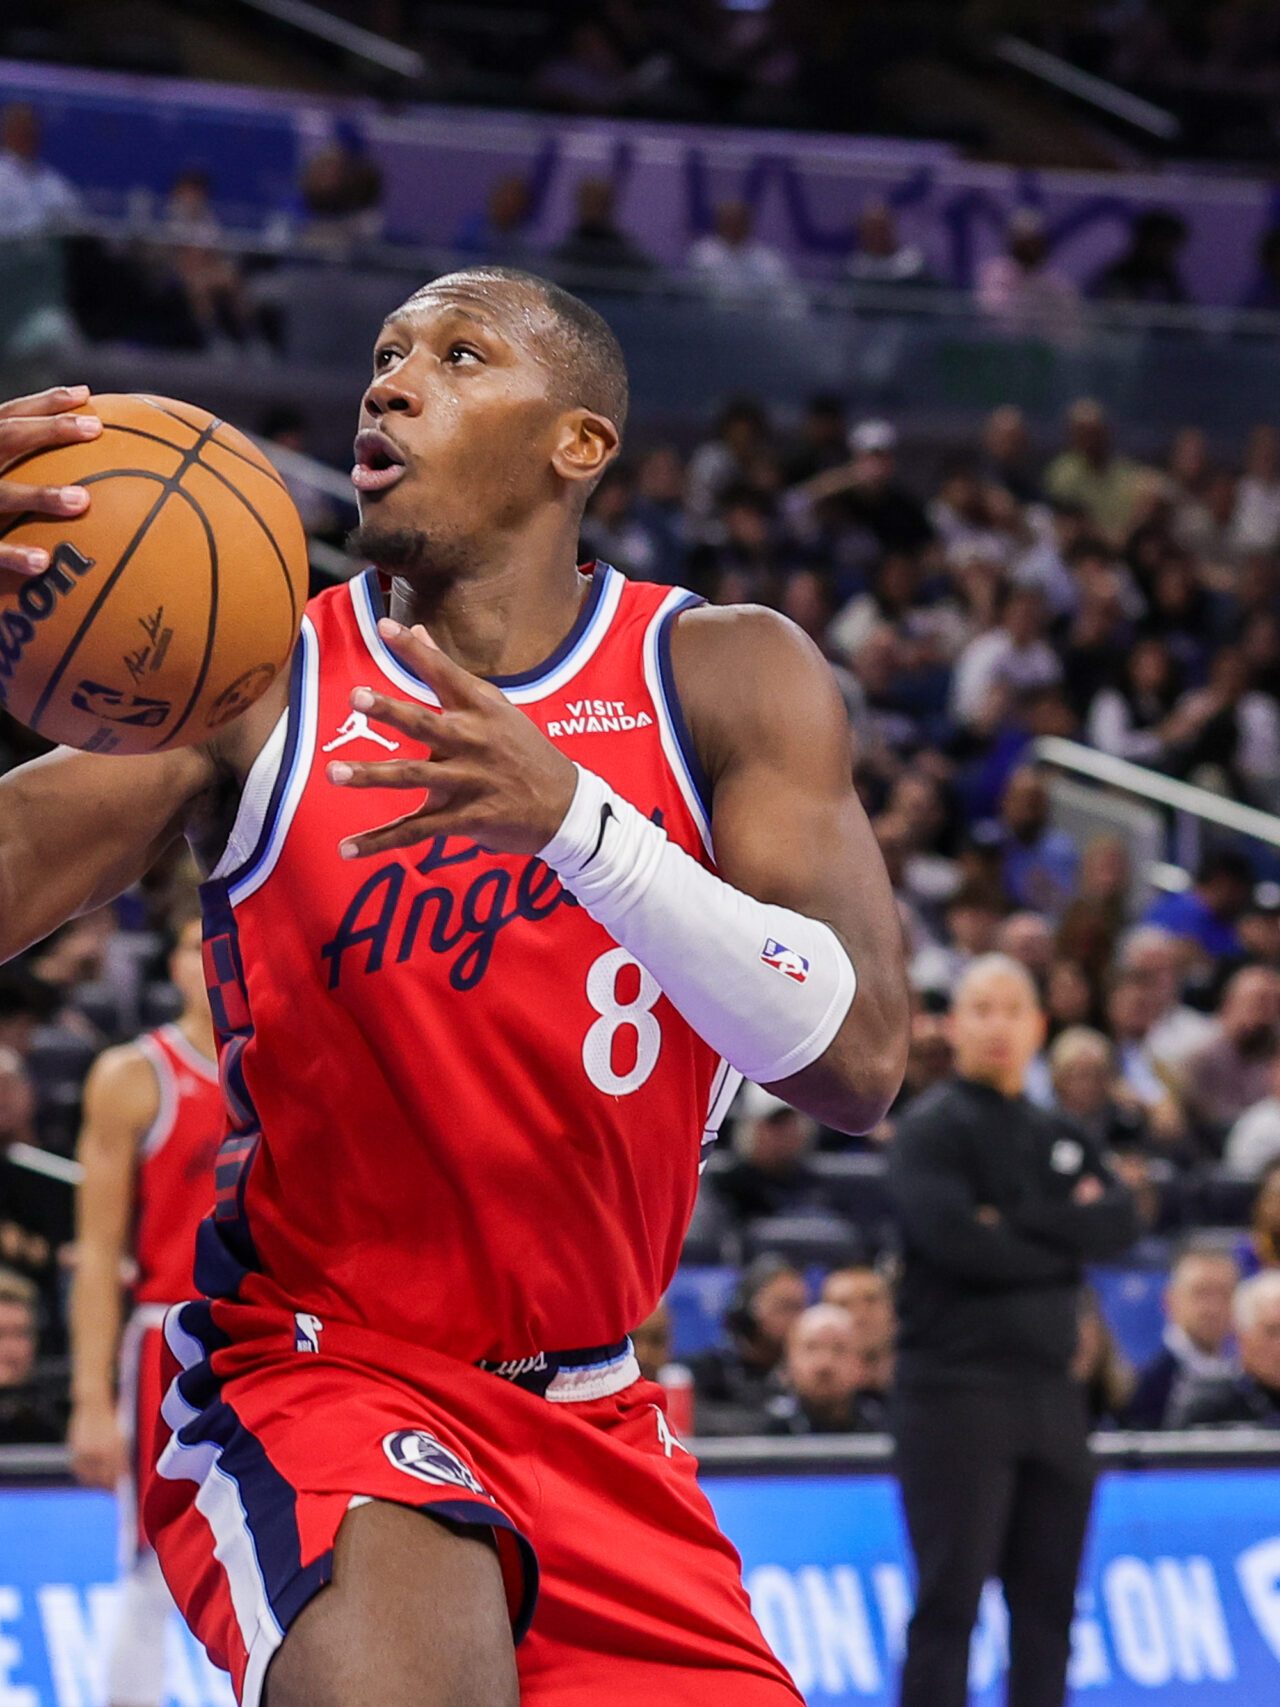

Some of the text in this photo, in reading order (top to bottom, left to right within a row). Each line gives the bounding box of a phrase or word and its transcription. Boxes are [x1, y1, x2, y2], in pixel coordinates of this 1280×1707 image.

[546, 711, 653, 738] RWANDA
[565, 699, 625, 717] VISIT
[321, 852, 582, 992] Ange
[582, 946, 663, 1096] 8
